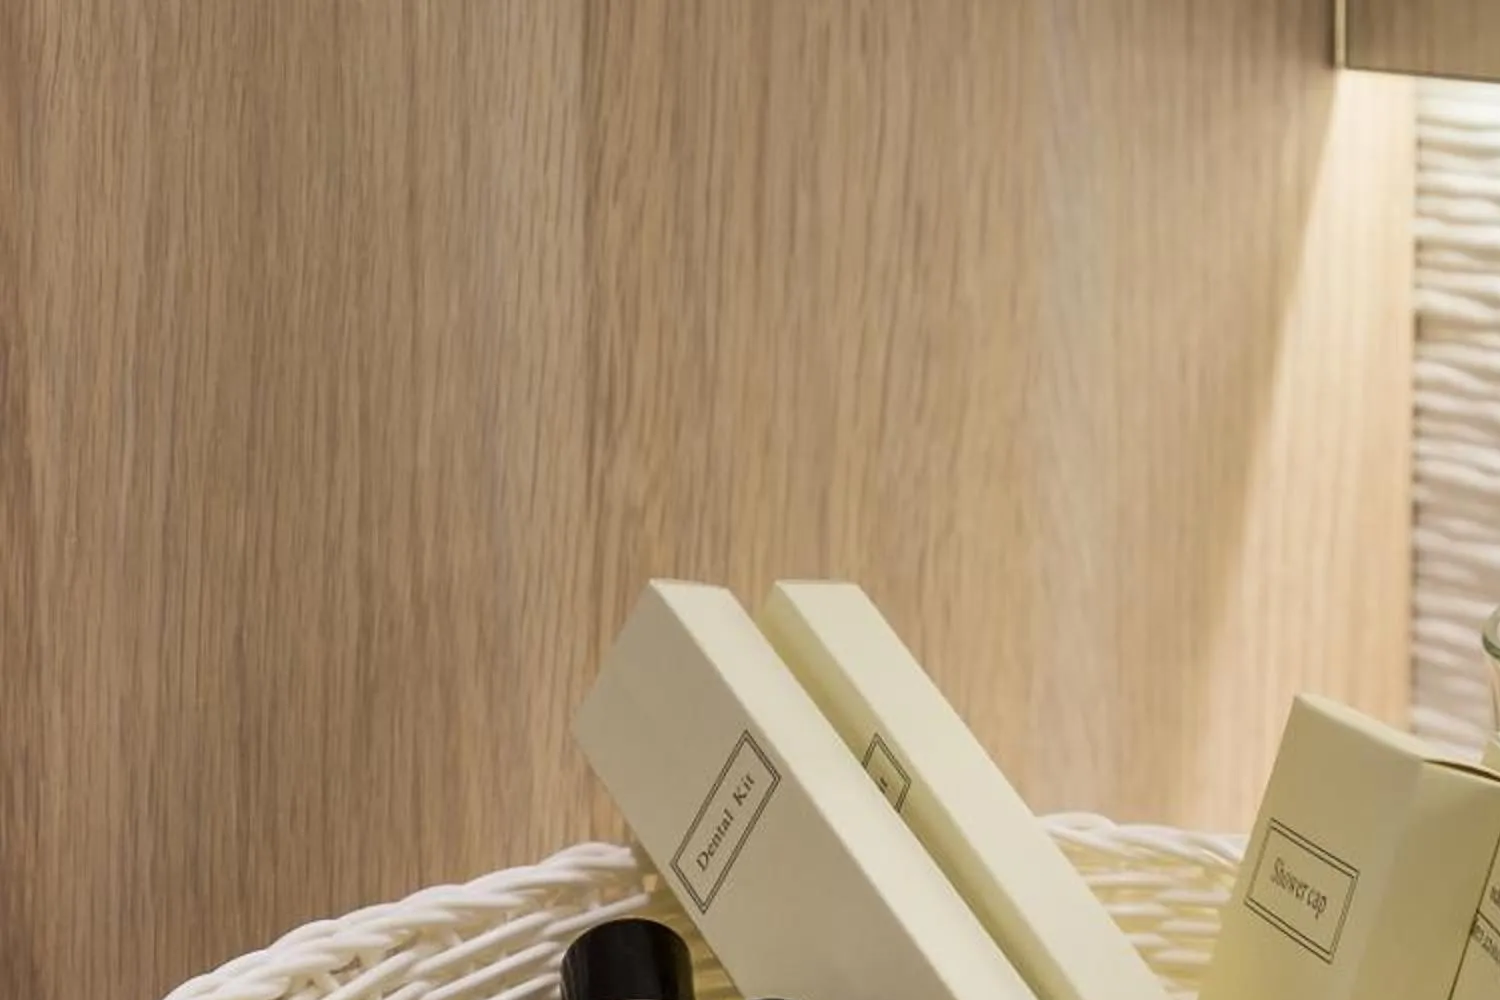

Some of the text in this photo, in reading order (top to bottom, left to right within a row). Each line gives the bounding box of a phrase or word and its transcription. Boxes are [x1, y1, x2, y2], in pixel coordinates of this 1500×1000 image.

[696, 772, 756, 873] Dental Kit
[1270, 856, 1328, 919] Shower cap
